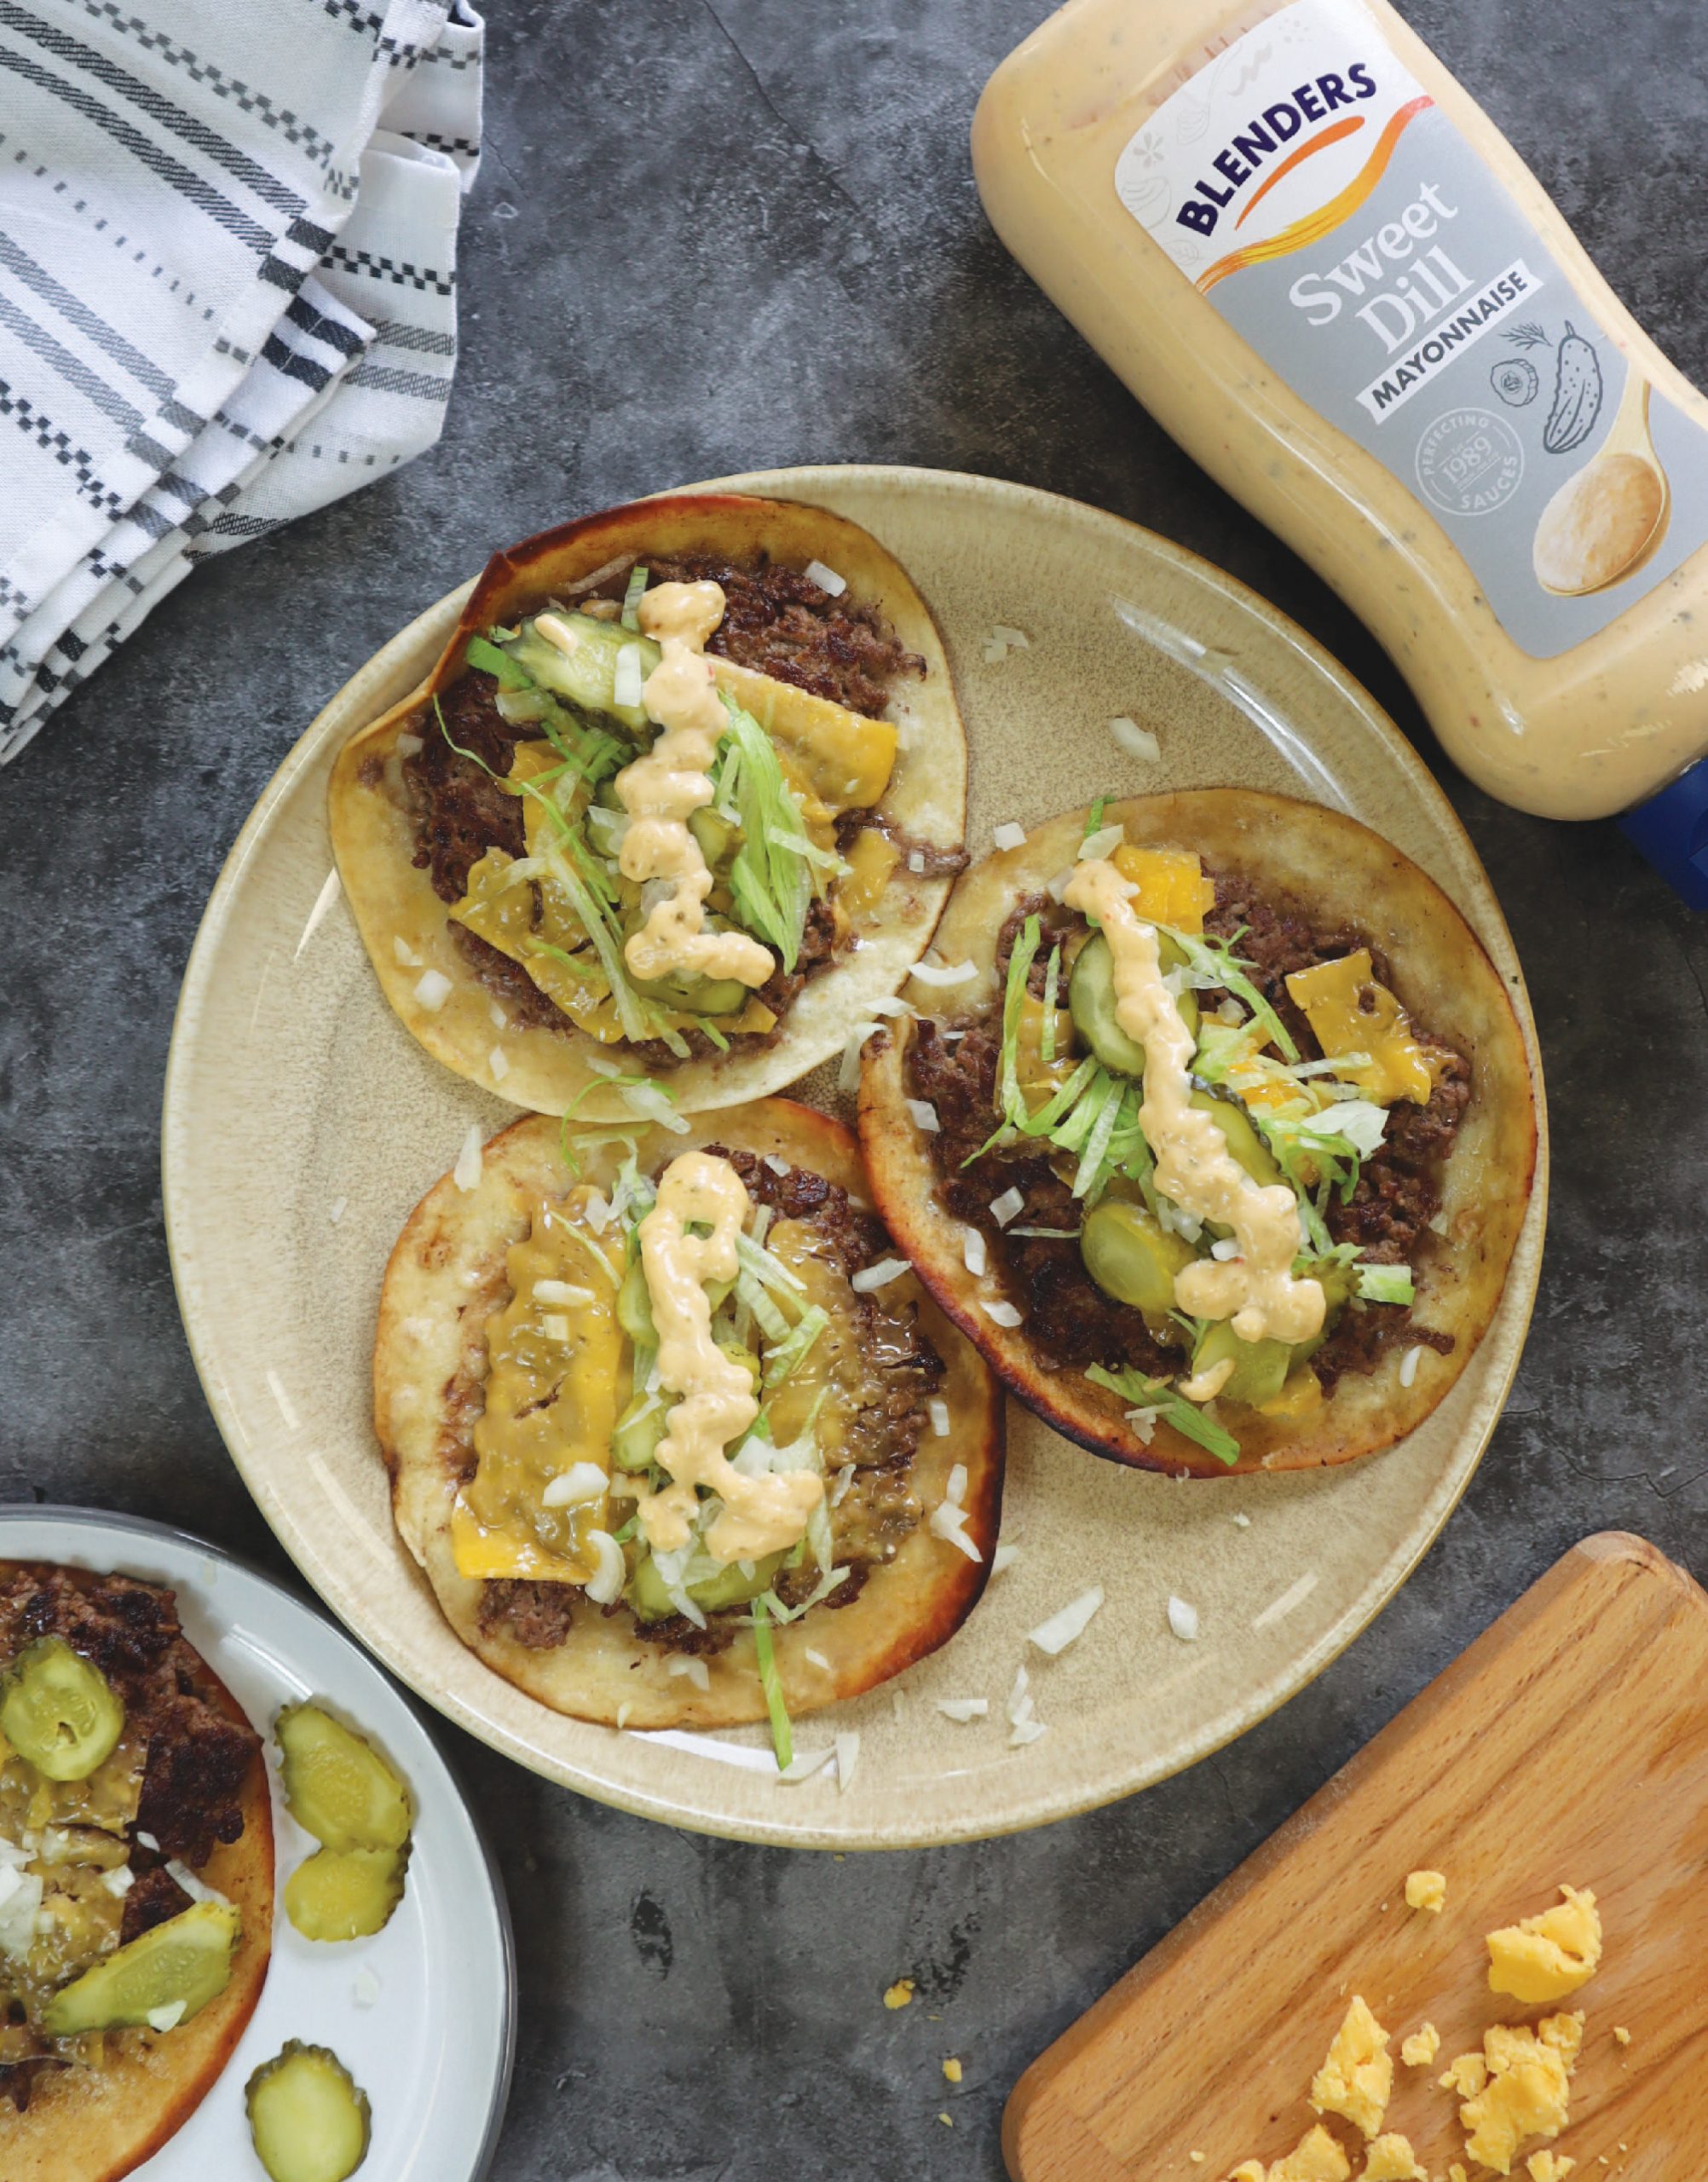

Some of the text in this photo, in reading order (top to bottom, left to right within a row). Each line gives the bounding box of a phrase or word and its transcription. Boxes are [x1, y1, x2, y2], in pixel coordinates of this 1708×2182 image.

[1176, 63, 1376, 237] BLENDERS
[1289, 182, 1458, 326] Sweet
[1355, 245, 1474, 355] Dill
[1372, 271, 1528, 409] MAYONNAISE
[1422, 415, 1490, 476] PERFECTING
[1443, 436, 1492, 484] 1989
[1460, 456, 1518, 510] SAUCES
